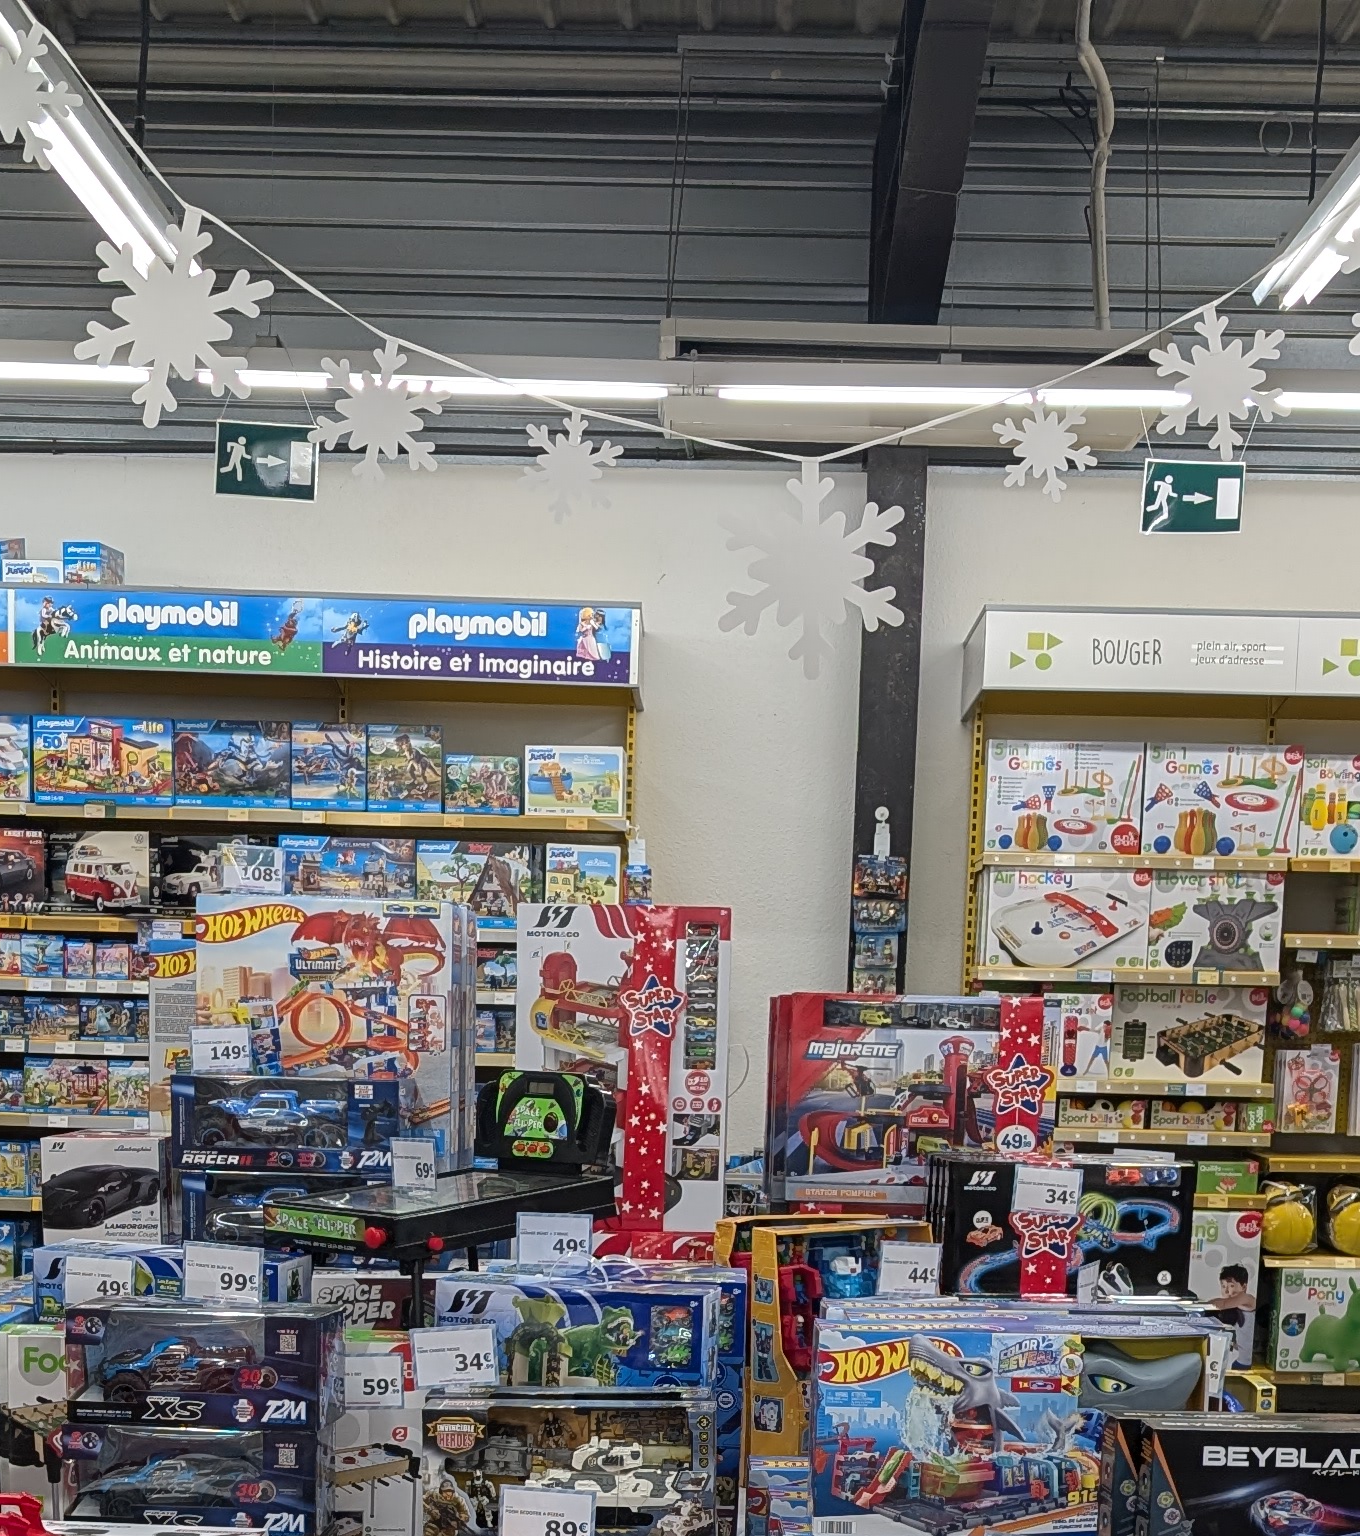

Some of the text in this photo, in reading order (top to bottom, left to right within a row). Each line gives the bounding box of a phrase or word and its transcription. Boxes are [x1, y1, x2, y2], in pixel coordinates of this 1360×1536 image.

[100, 598, 237, 630] playmobil
[408, 608, 547, 639] playmobil
[64, 640, 272, 666] Animaux et nature
[1091, 638, 1162, 666] BOUGER
[1196, 641, 1267, 654] plein air, sport
[358, 651, 595, 678] Histoire et imaginaire
[295, 957, 341, 971] ULTIMATE
[625, 989, 672, 1009] SUPER
[1120, 987, 1217, 1004] Football table
[634, 1008, 672, 1026] STAR
[1060, 1111, 1114, 1128] Sport balls
[1283, 1274, 1337, 1292] Bouncy
[1306, 1286, 1346, 1304] Pony
